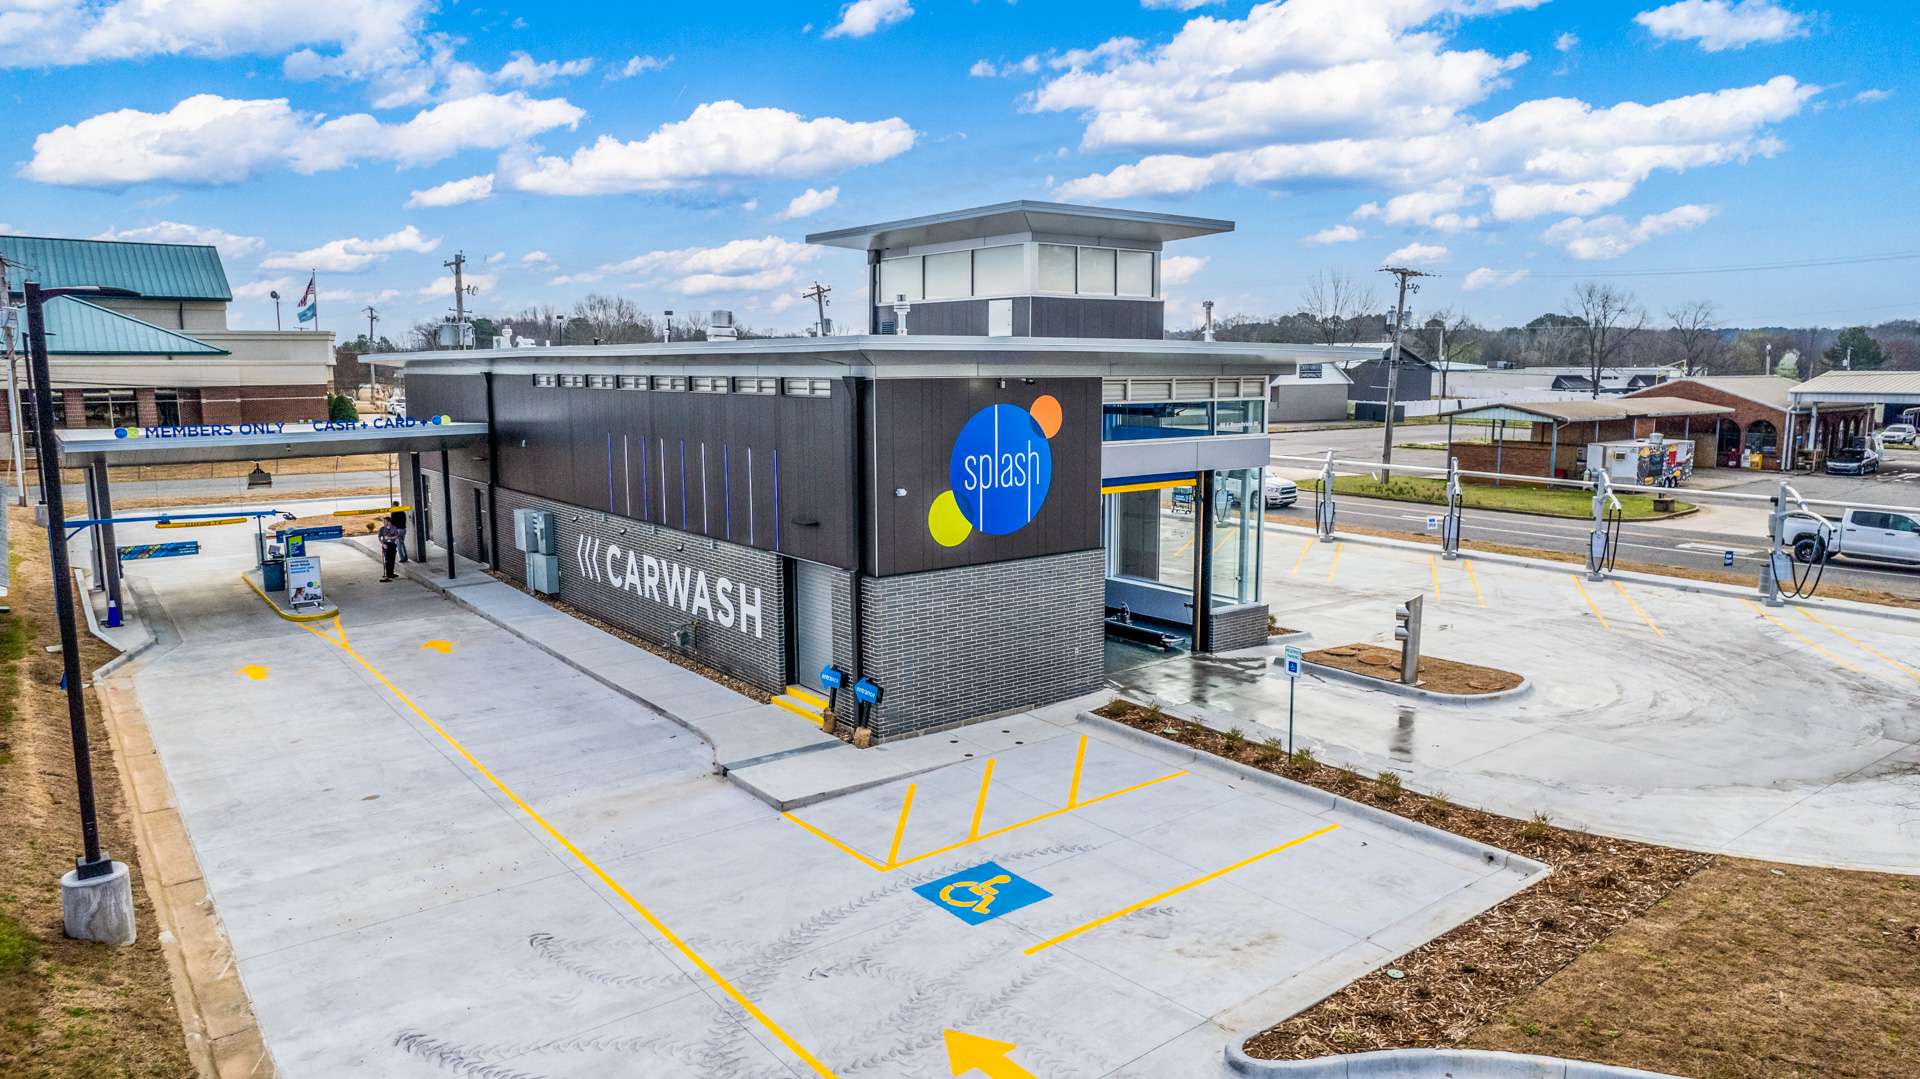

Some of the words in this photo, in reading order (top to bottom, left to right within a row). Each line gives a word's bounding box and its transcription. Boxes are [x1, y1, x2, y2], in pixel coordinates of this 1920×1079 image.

[145, 424, 233, 439] MEMBERS
[239, 421, 285, 435] ONLY
[313, 418, 356, 431] CASH
[373, 415, 416, 429] CARD
[964, 404, 1040, 532] splash
[606, 544, 763, 639] CARWASH
[856, 686, 876, 699] entrance
